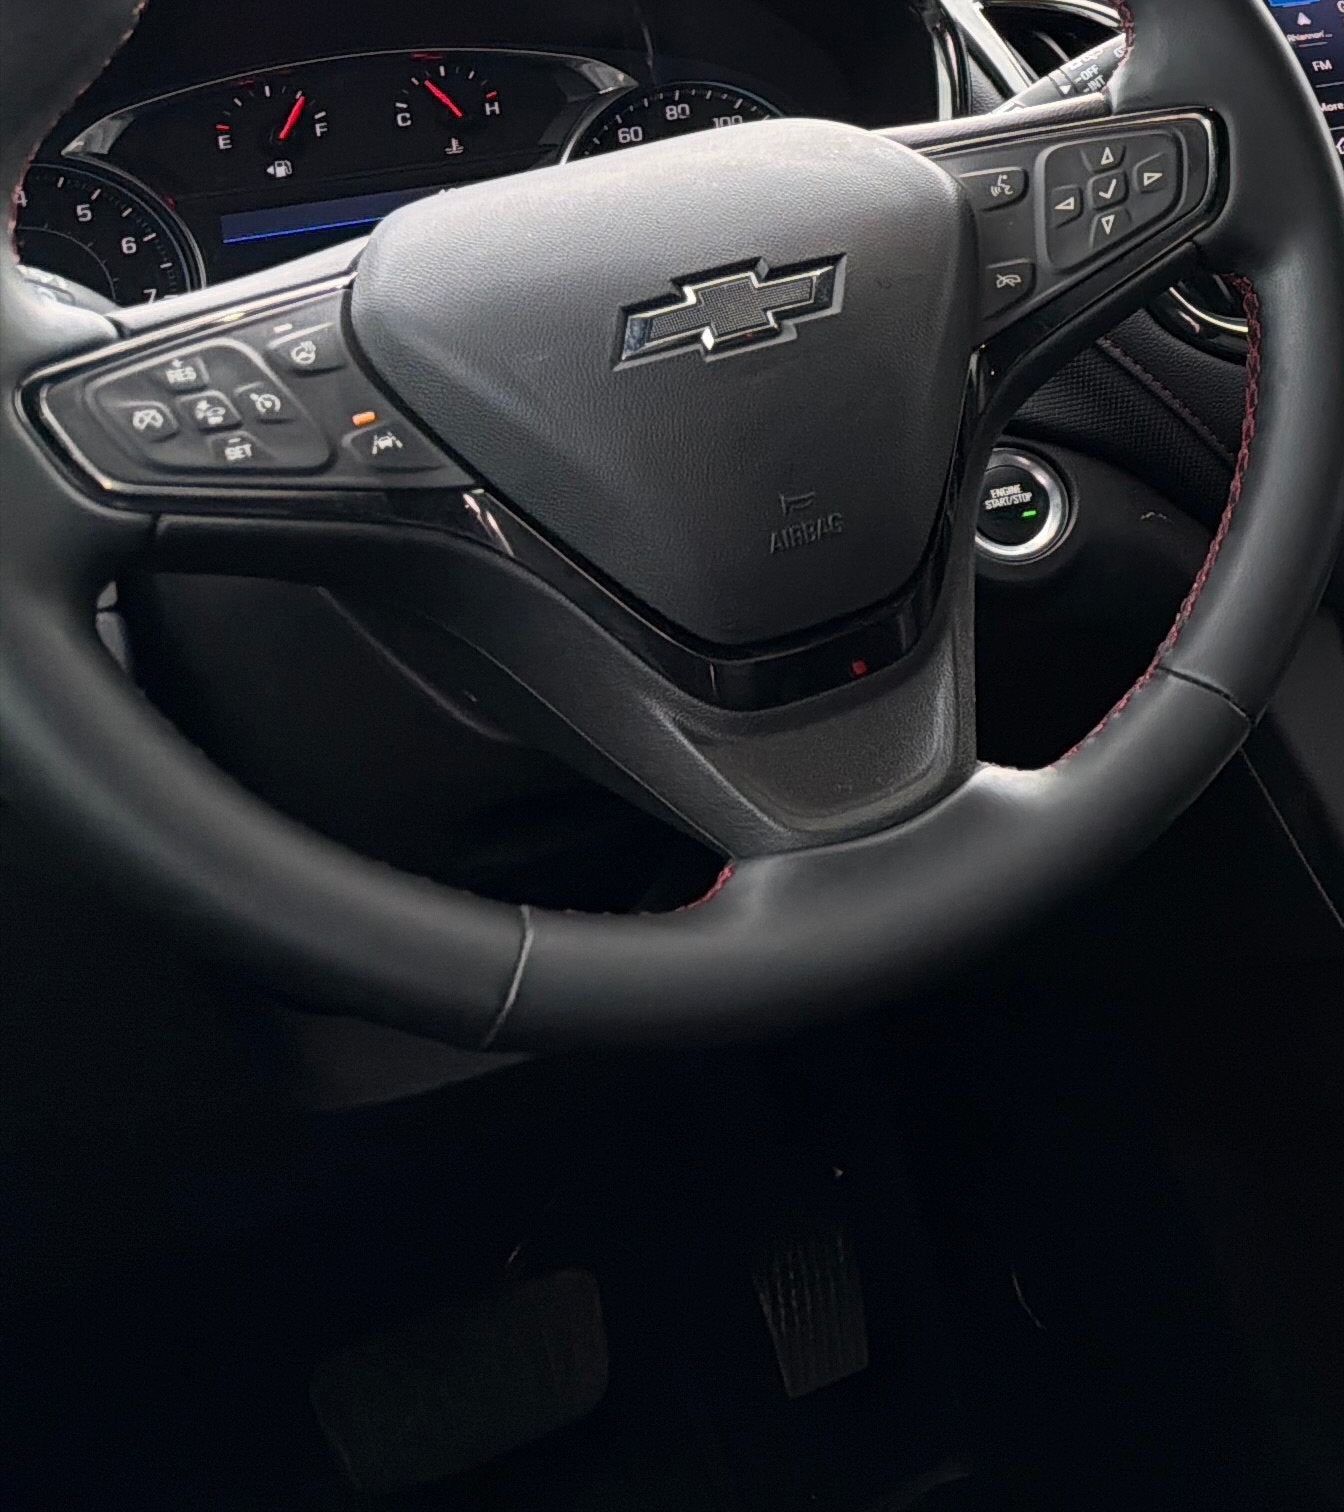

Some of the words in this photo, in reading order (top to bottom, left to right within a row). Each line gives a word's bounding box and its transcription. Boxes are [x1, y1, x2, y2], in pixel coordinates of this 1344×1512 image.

[1080, 64, 1099, 81] OFF
[1311, 59, 1333, 72] FM
[484, 101, 501, 117] H
[664, 103, 691, 121] 80
[395, 112, 412, 128] C
[314, 121, 329, 138] F
[617, 126, 643, 144] 60
[218, 134, 233, 151] E
[76, 203, 93, 222] 5
[121, 236, 137, 255] 6
[142, 288, 158, 304] 7
[165, 366, 197, 384] RES
[224, 443, 253, 461] SET
[989, 483, 1021, 499] ENGINE
[984, 491, 1033, 510] START/STOP
[770, 512, 843, 554] AIRBAG
